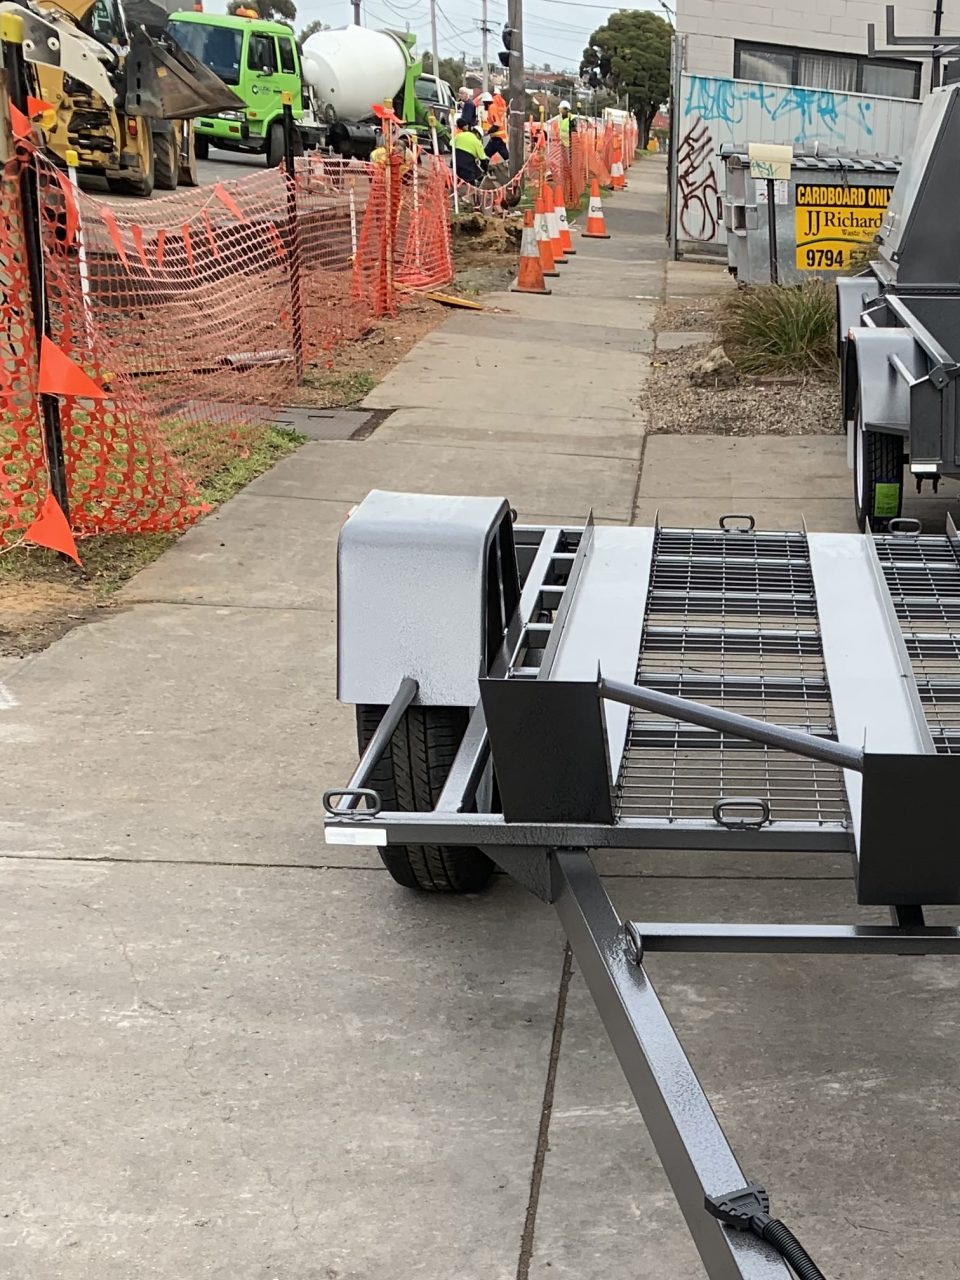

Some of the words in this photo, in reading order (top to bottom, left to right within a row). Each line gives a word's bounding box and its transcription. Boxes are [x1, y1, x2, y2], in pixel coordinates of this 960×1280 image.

[797, 186, 866, 206] CARDBOARD
[804, 210, 821, 236] JJ
[806, 249, 844, 267] 9794
